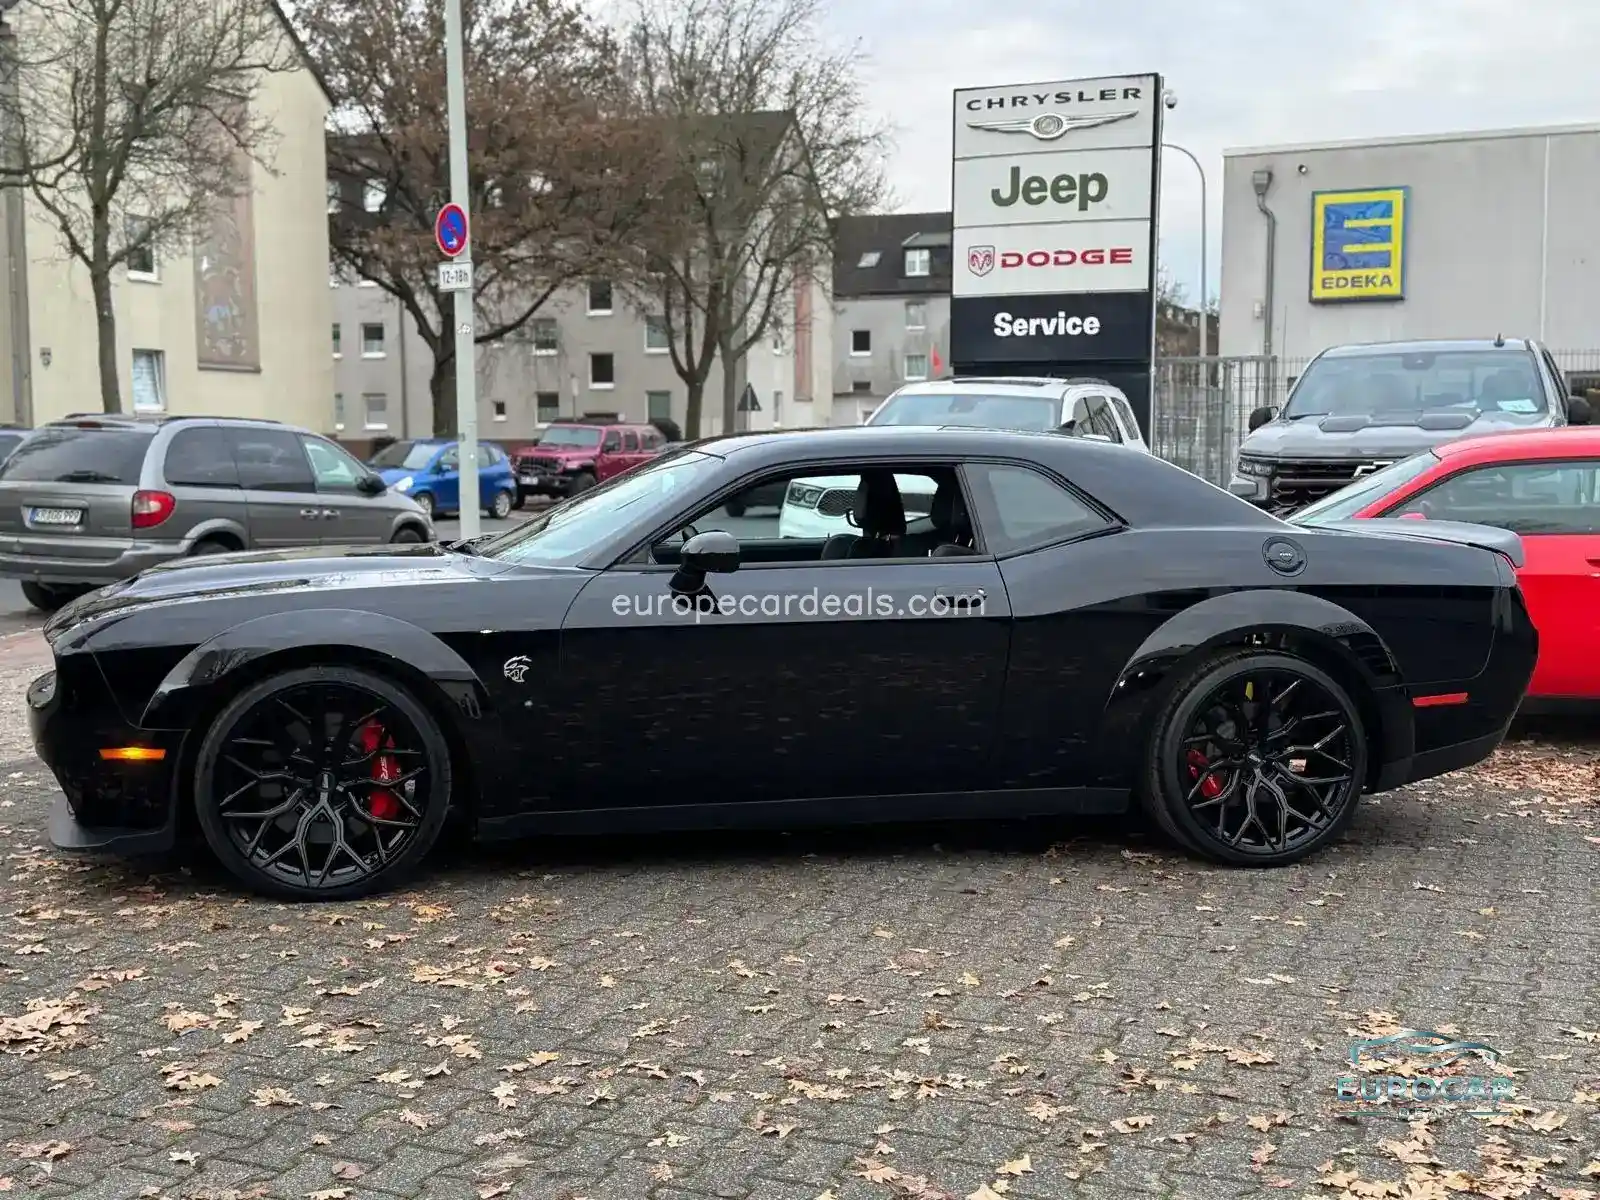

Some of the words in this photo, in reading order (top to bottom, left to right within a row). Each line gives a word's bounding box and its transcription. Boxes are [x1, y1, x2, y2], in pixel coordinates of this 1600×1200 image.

[966, 88, 1142, 111] CHRYSLER
[991, 166, 1108, 211] Jeep
[1001, 248, 1132, 268] DODGE
[1322, 275, 1393, 289] EDEKA
[994, 311, 1100, 336] Service
